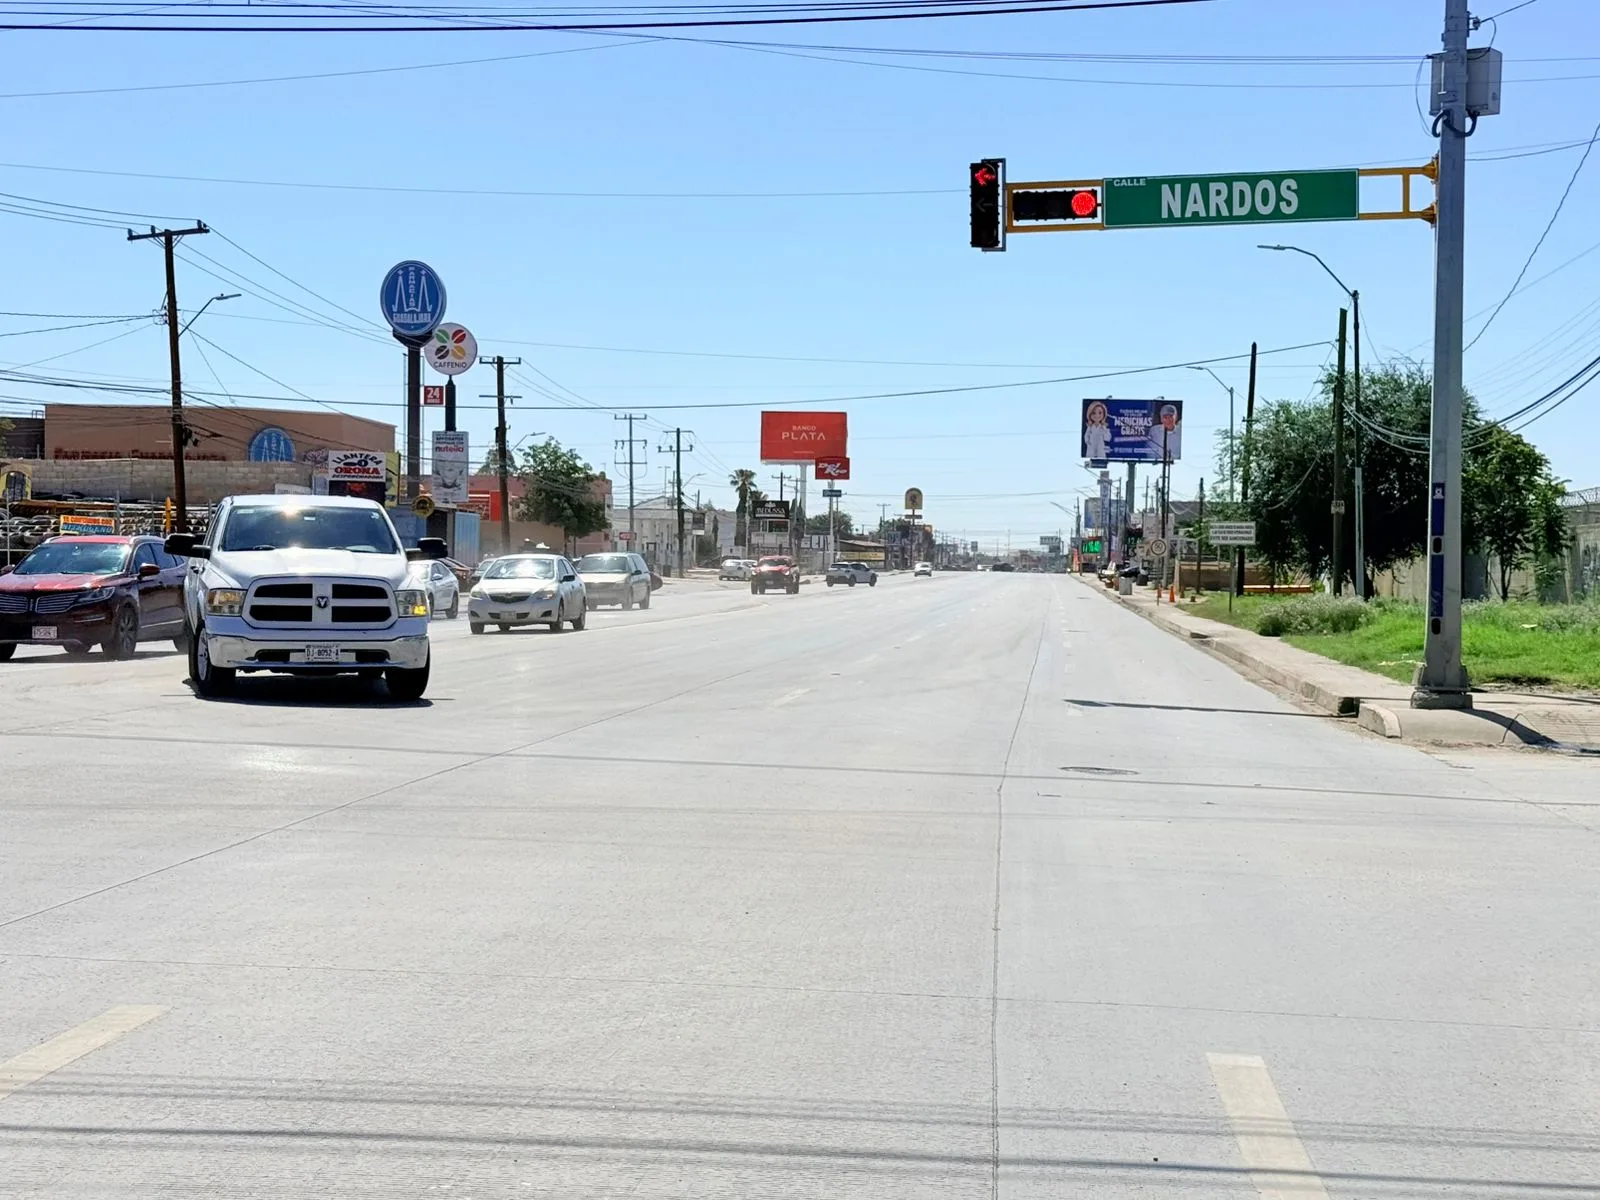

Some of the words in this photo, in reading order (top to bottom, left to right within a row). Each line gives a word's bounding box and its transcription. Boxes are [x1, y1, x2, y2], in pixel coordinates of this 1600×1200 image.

[1113, 178, 1147, 187] CALLE
[1161, 179, 1299, 219] NARDOS
[433, 361, 467, 369] CAFFENIO
[426, 387, 440, 399] 24
[781, 432, 826, 440] PLATA
[332, 453, 383, 466] LLANTERA
